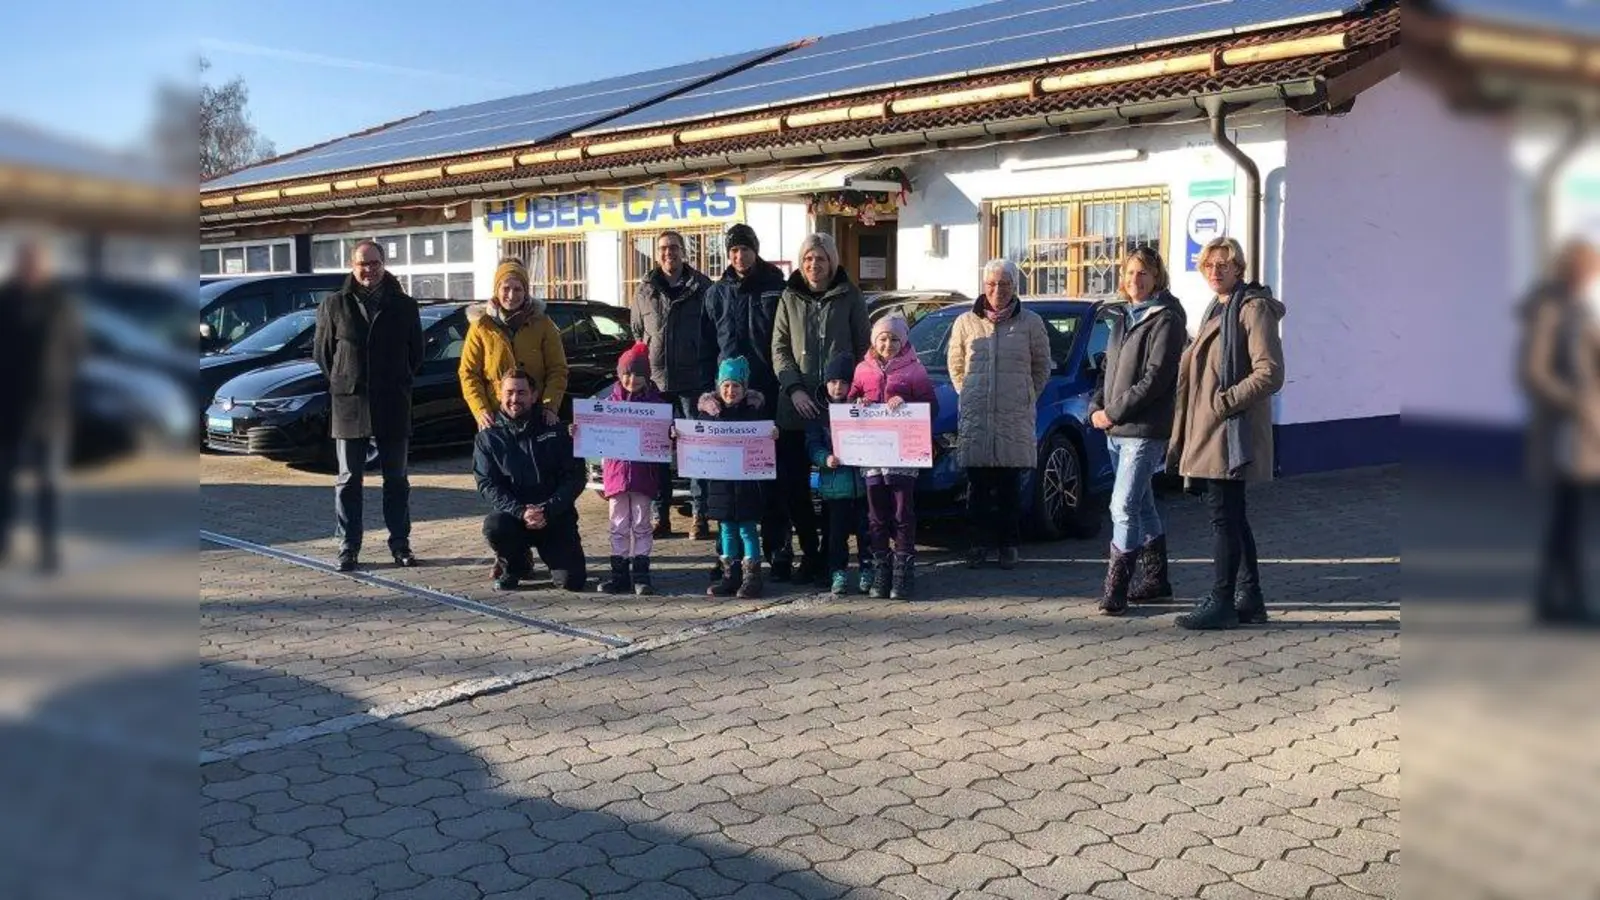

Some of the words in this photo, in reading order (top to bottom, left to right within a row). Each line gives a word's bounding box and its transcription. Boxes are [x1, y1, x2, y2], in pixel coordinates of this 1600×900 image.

[606, 404, 656, 416] Sparkasse
[862, 407, 913, 418] Sparkasse
[707, 425, 758, 435] Sparkasse
